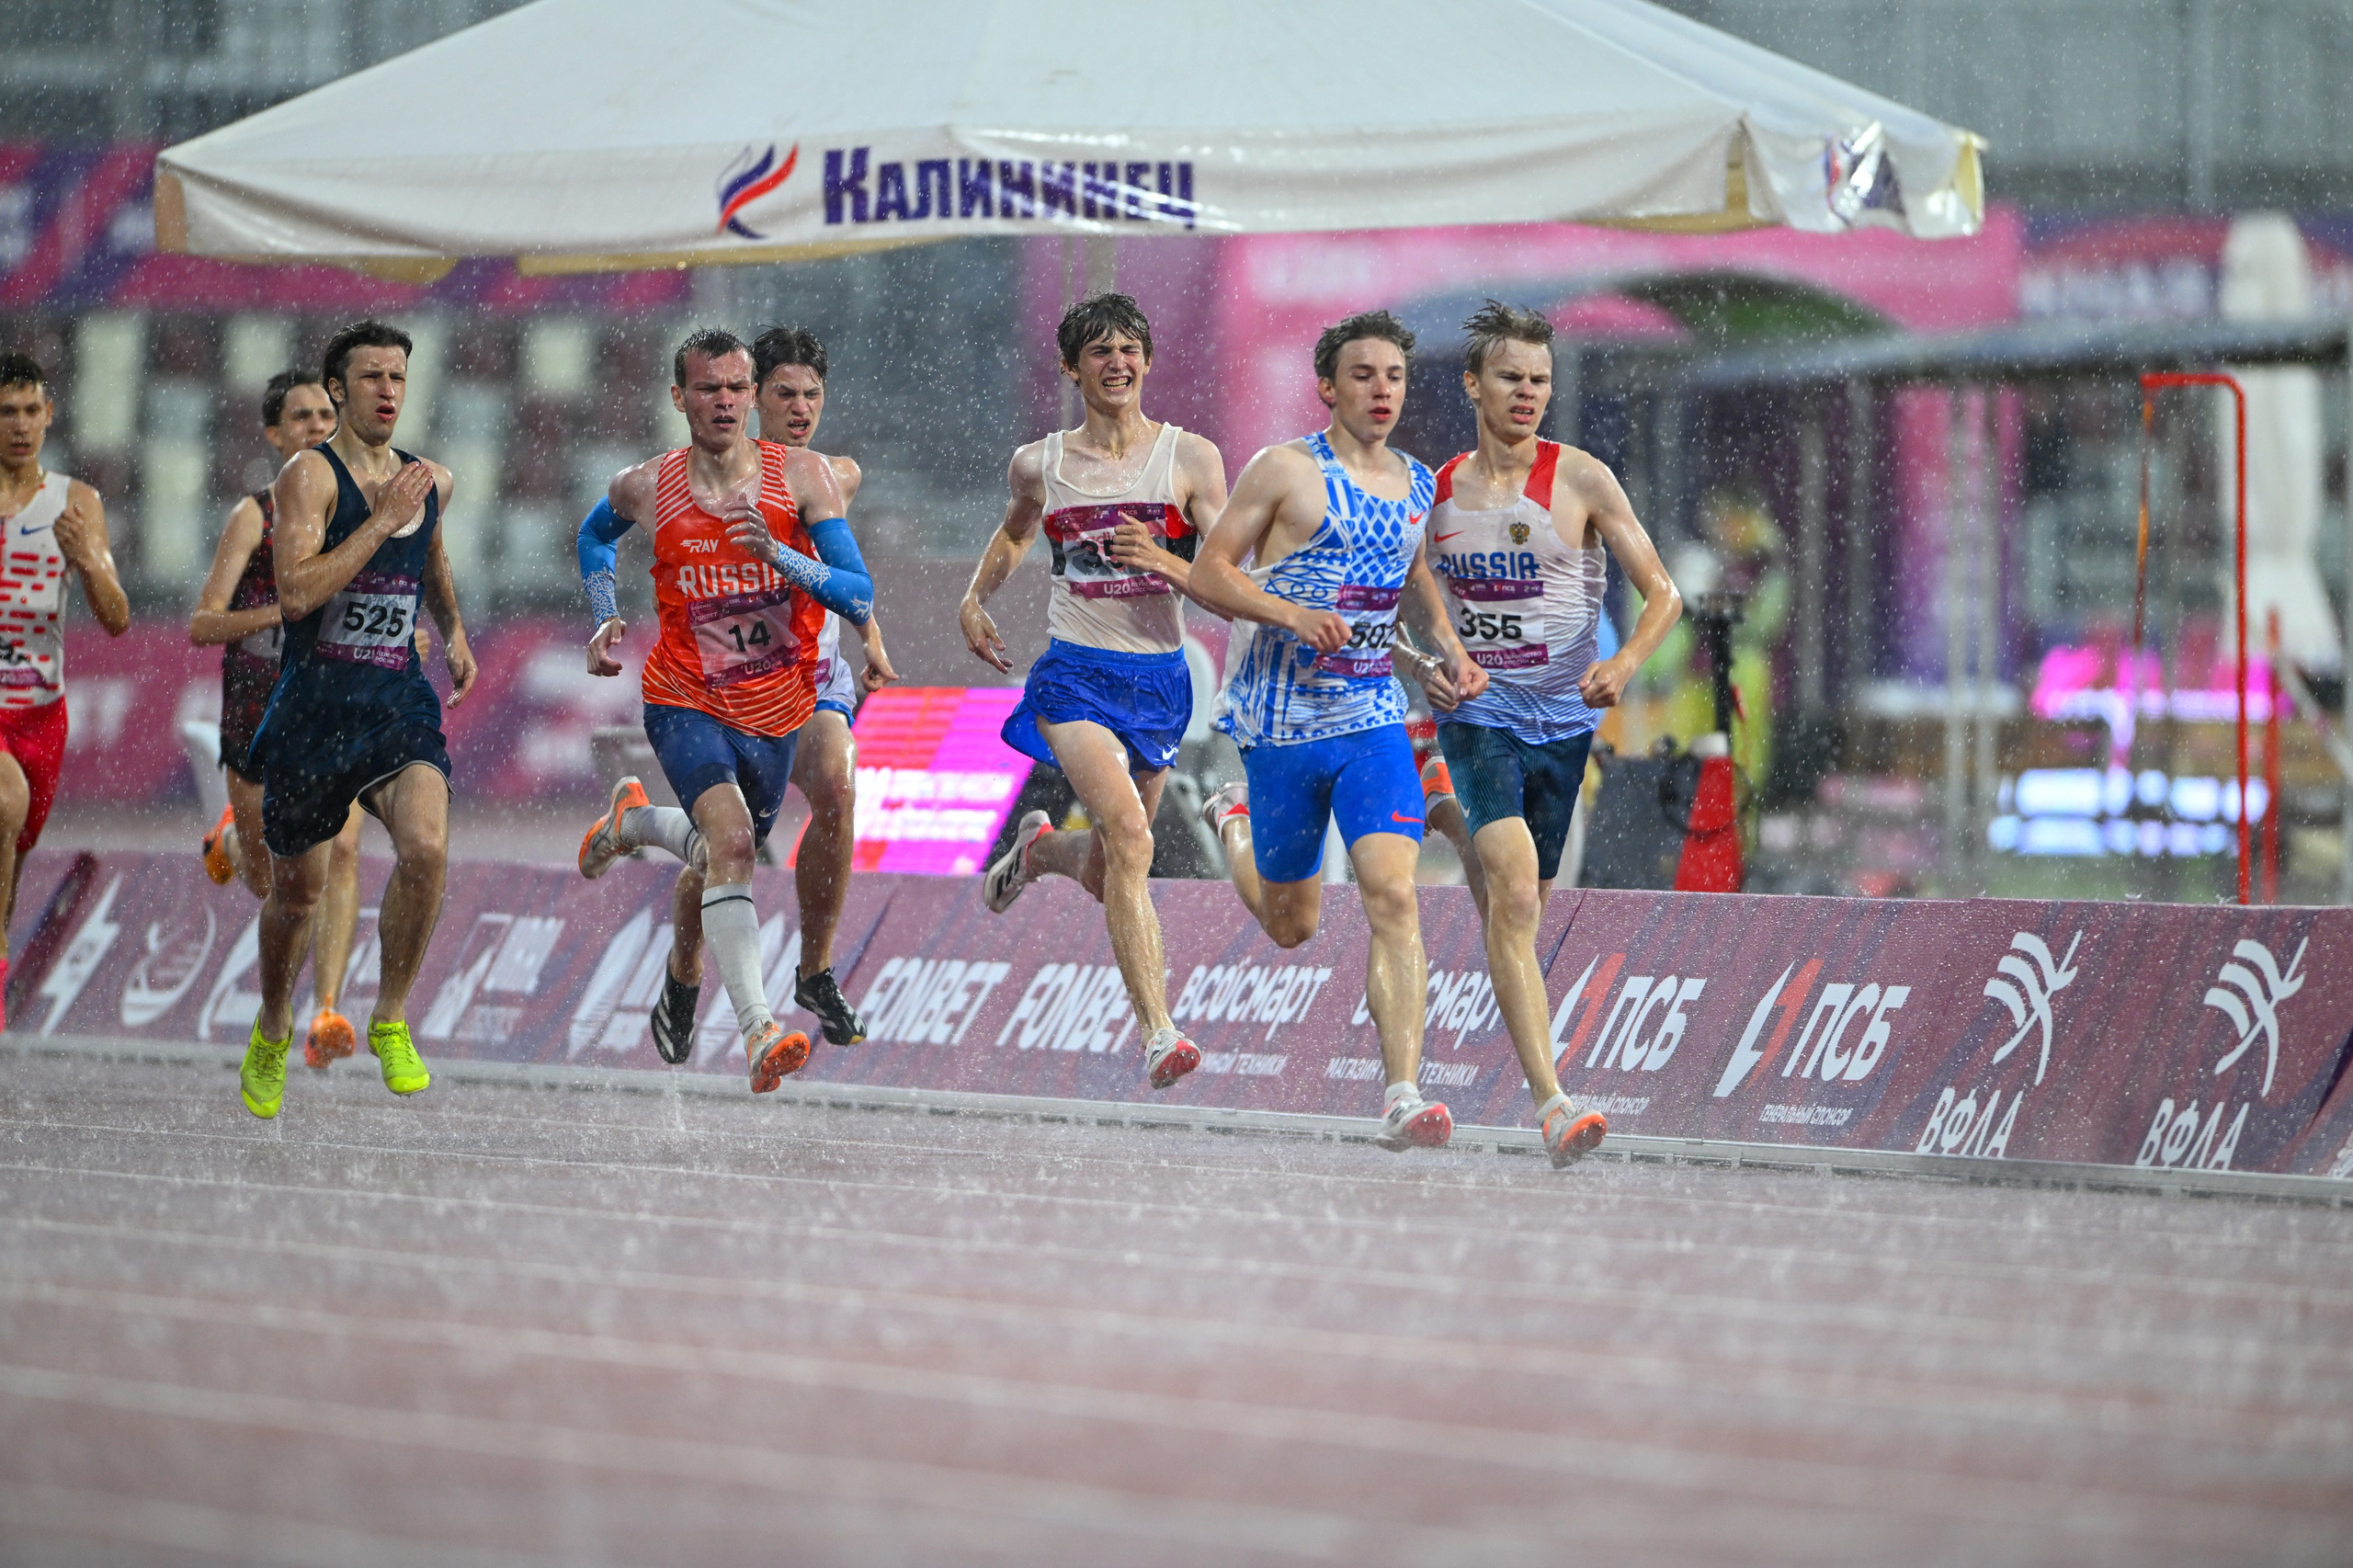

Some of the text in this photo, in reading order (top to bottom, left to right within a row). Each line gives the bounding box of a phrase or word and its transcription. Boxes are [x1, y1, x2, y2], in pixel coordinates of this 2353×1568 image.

[680, 539, 719, 553] RAY
[1080, 540, 1124, 569] 35
[1436, 551, 1540, 580] RUSSIA
[1104, 583, 1131, 595] U20
[342, 601, 407, 638] 525
[694, 611, 718, 622] FONBET
[1459, 608, 1522, 641] 355
[728, 619, 772, 653] 14
[744, 659, 772, 676] U20
[1476, 653, 1504, 666] U20
[858, 957, 1011, 1046] FONBET
[1586, 975, 1708, 1072] ПСБ
[1781, 983, 1912, 1082] ПСБ
[1234, 1053, 1288, 1075] ТЕХНИКИ
[1324, 1058, 1382, 1081] МАГАЗИН
[1419, 1062, 1480, 1086] ТЕХНИКИ
[1610, 1096, 1651, 1115] СПОНСОР
[1758, 1103, 1853, 1126] ГЕНЕРАЛЬНЫЙ СПОНСОР
[1915, 1086, 2023, 1160] ВФЛА
[2133, 1098, 2250, 1171] ВФЛА
